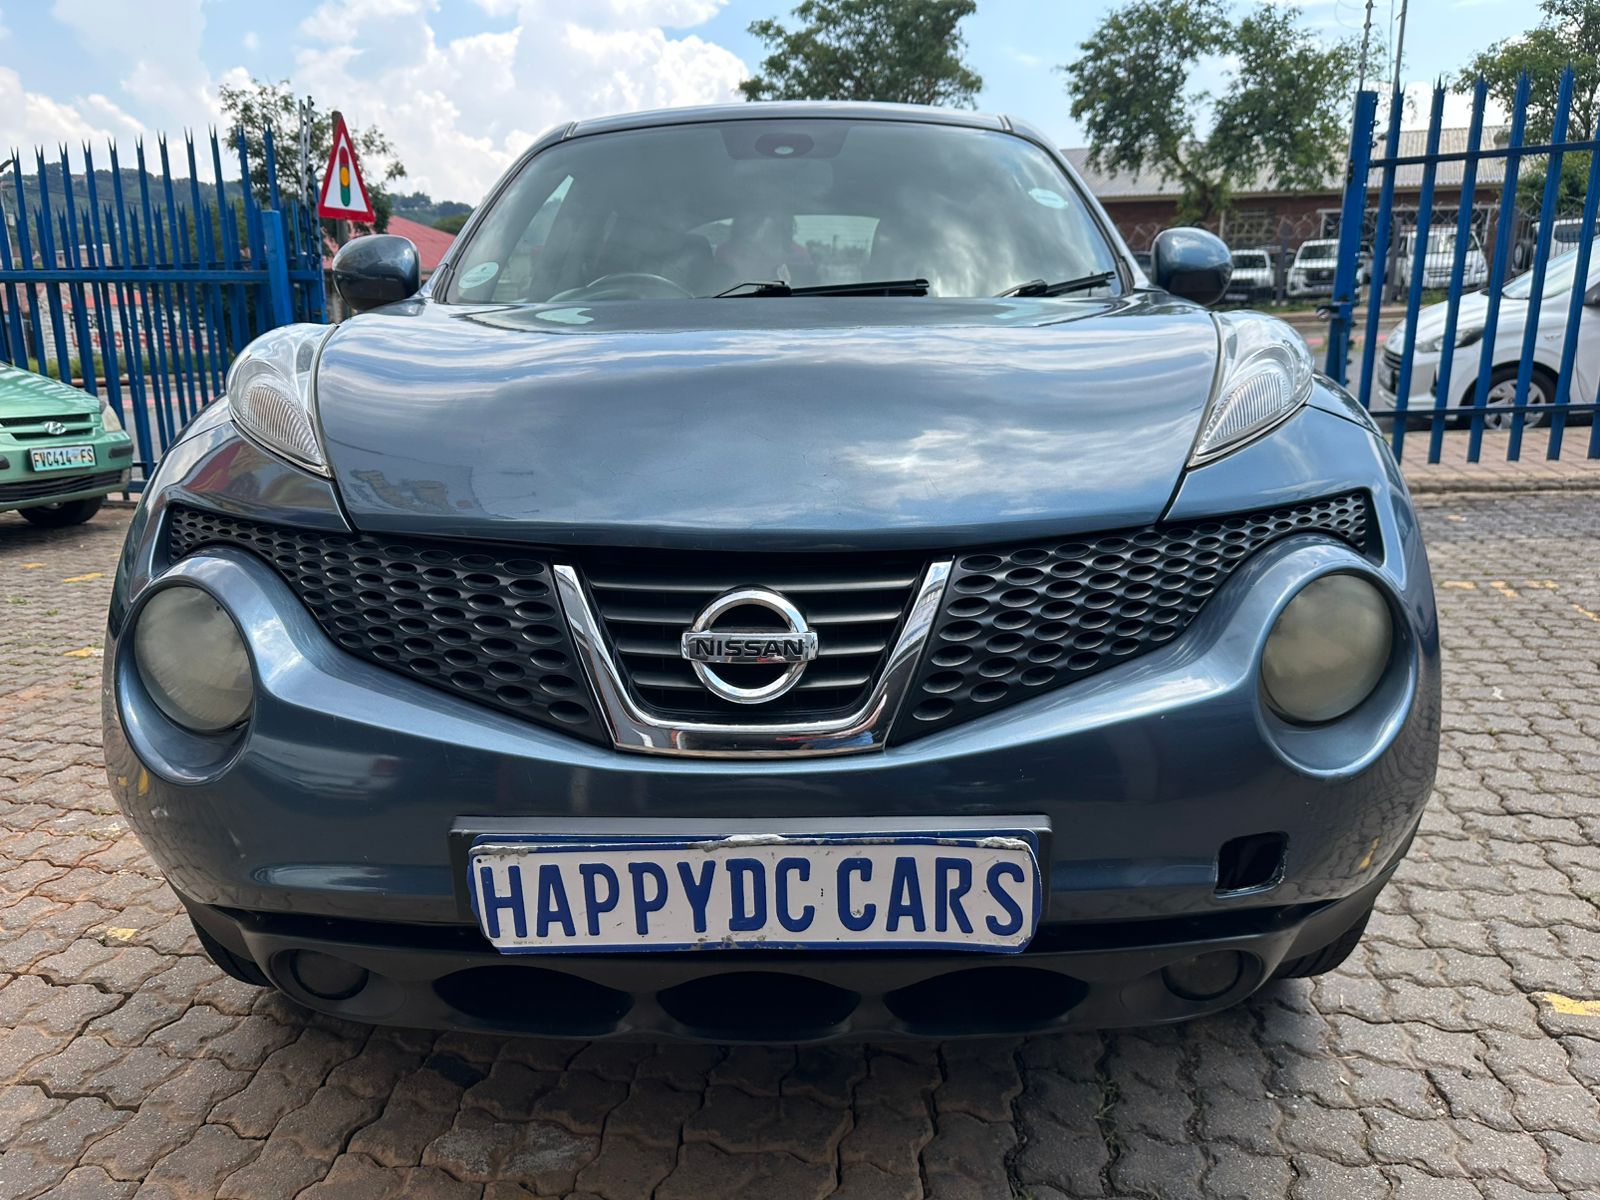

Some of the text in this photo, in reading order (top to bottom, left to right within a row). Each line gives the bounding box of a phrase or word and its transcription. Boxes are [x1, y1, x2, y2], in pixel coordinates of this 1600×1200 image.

[80, 448, 94, 464] FS
[695, 639, 803, 656] NISSAN
[483, 857, 1025, 938] HAPPYDC CARS
